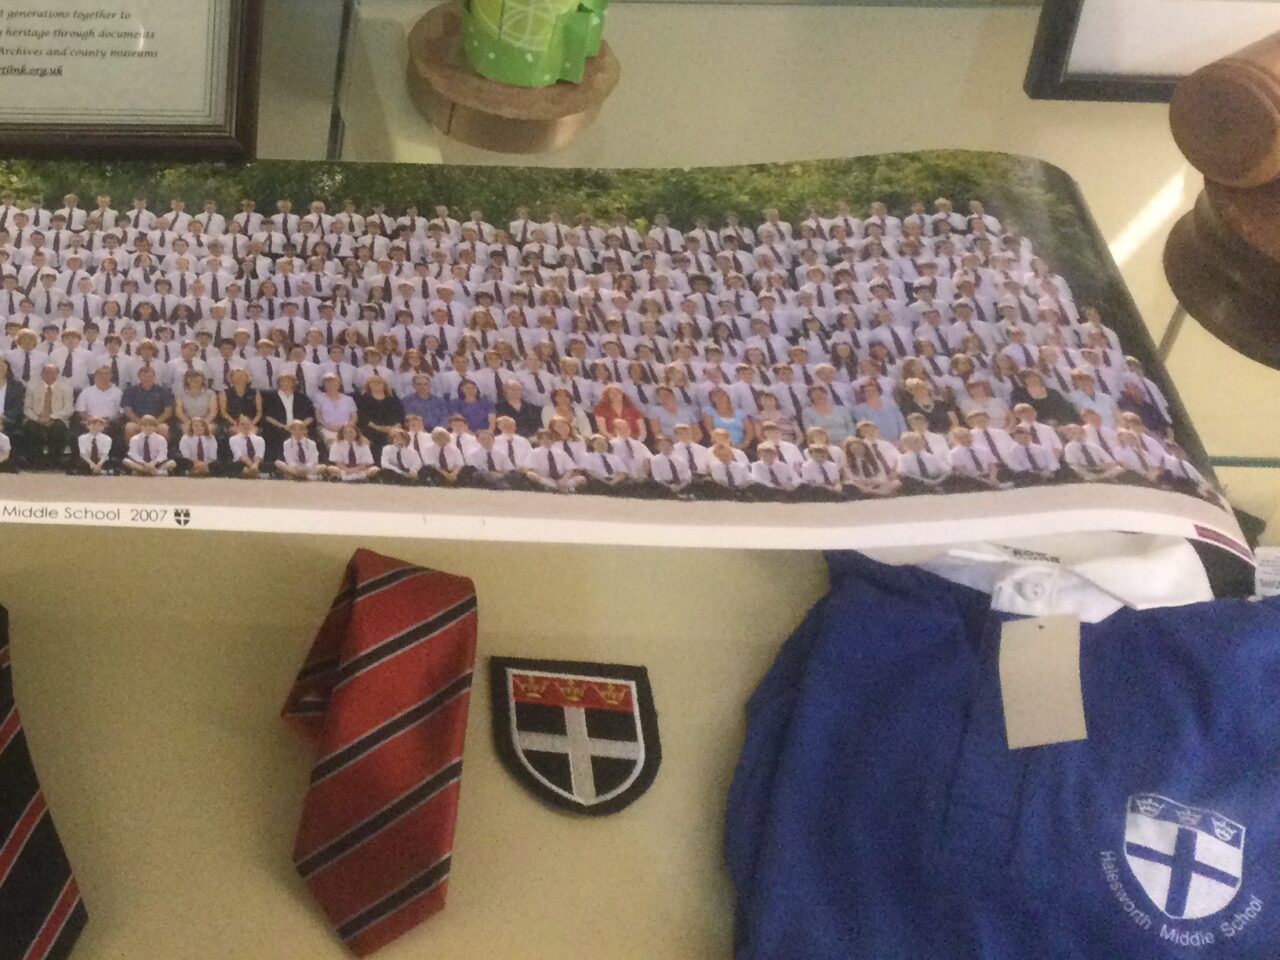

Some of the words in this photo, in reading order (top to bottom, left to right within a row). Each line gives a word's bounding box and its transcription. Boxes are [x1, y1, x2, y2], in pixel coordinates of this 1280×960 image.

[7, 10, 70, 21] generations
[73, 10, 116, 21] together
[120, 10, 131, 19] to
[5, 28, 50, 40] heritage
[53, 28, 95, 41] through
[45, 47, 67, 57] and
[70, 49, 106, 59] county
[110, 49, 158, 58] museums
[3, 504, 59, 520] Middle
[64, 506, 121, 522] School
[130, 508, 167, 523] 2007
[1100, 850, 1153, 931] Halesworth
[1160, 924, 1216, 948] Middle
[1220, 894, 1265, 938] School
